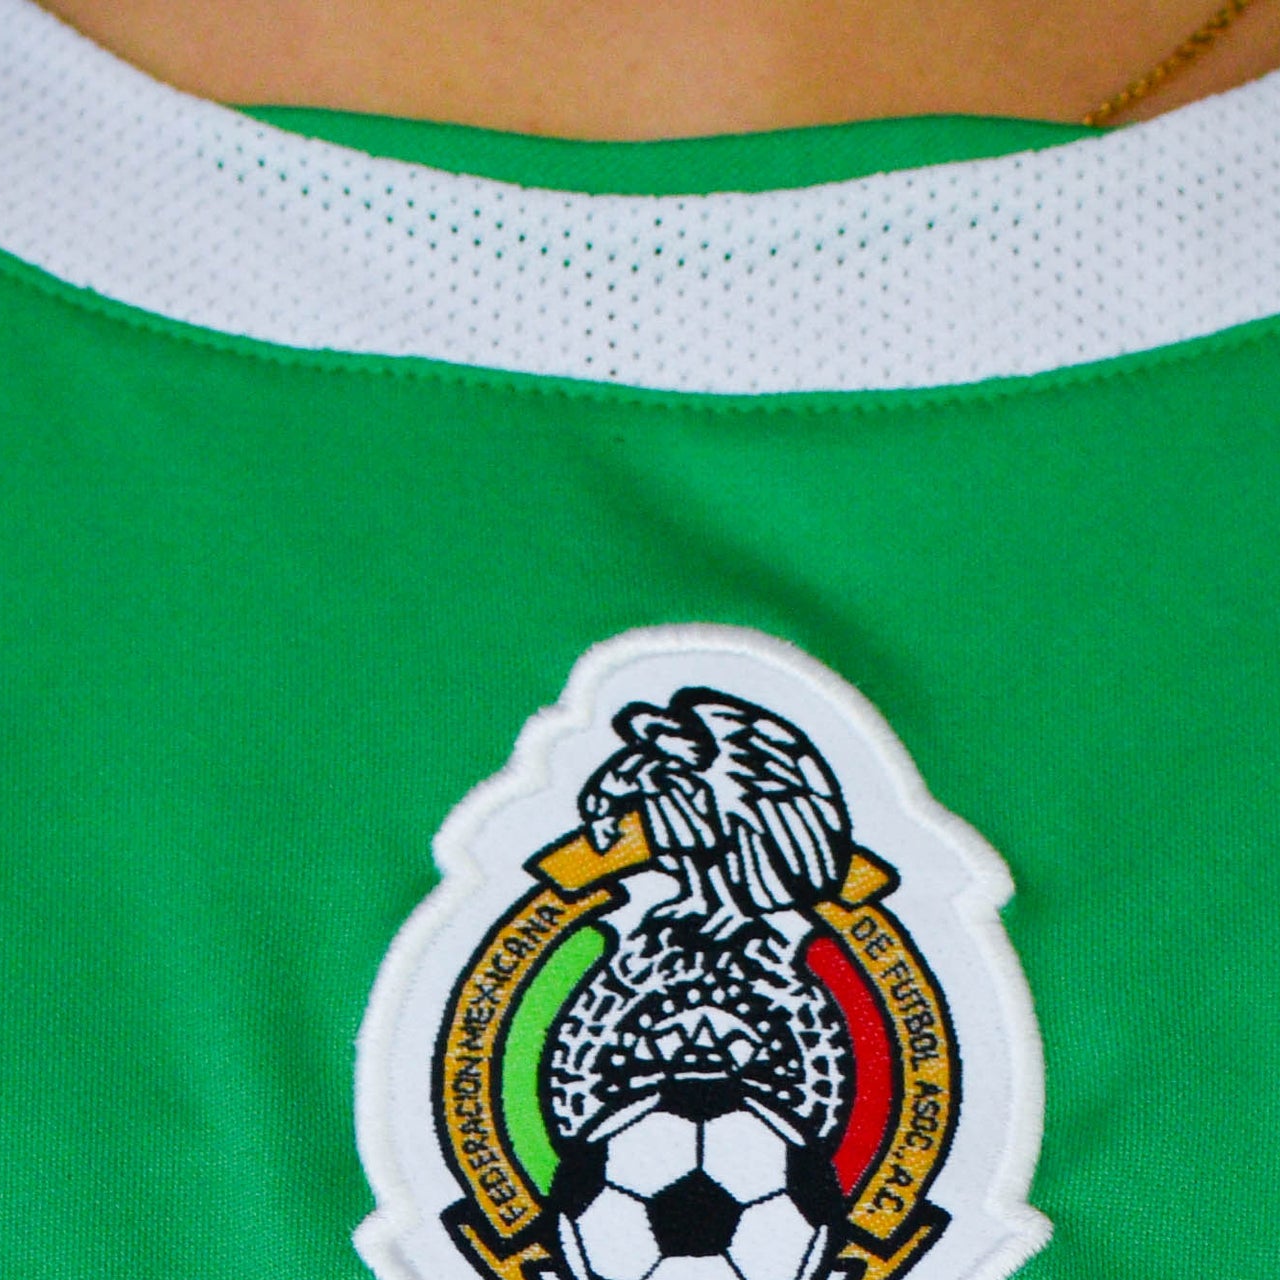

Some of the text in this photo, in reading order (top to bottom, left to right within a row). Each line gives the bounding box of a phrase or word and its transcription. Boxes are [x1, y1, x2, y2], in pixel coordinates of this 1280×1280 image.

[453, 905, 565, 1226] FEDERACION MEXICANA
[851, 916, 894, 960] DE
[880, 960, 939, 1072] FUTBOL
